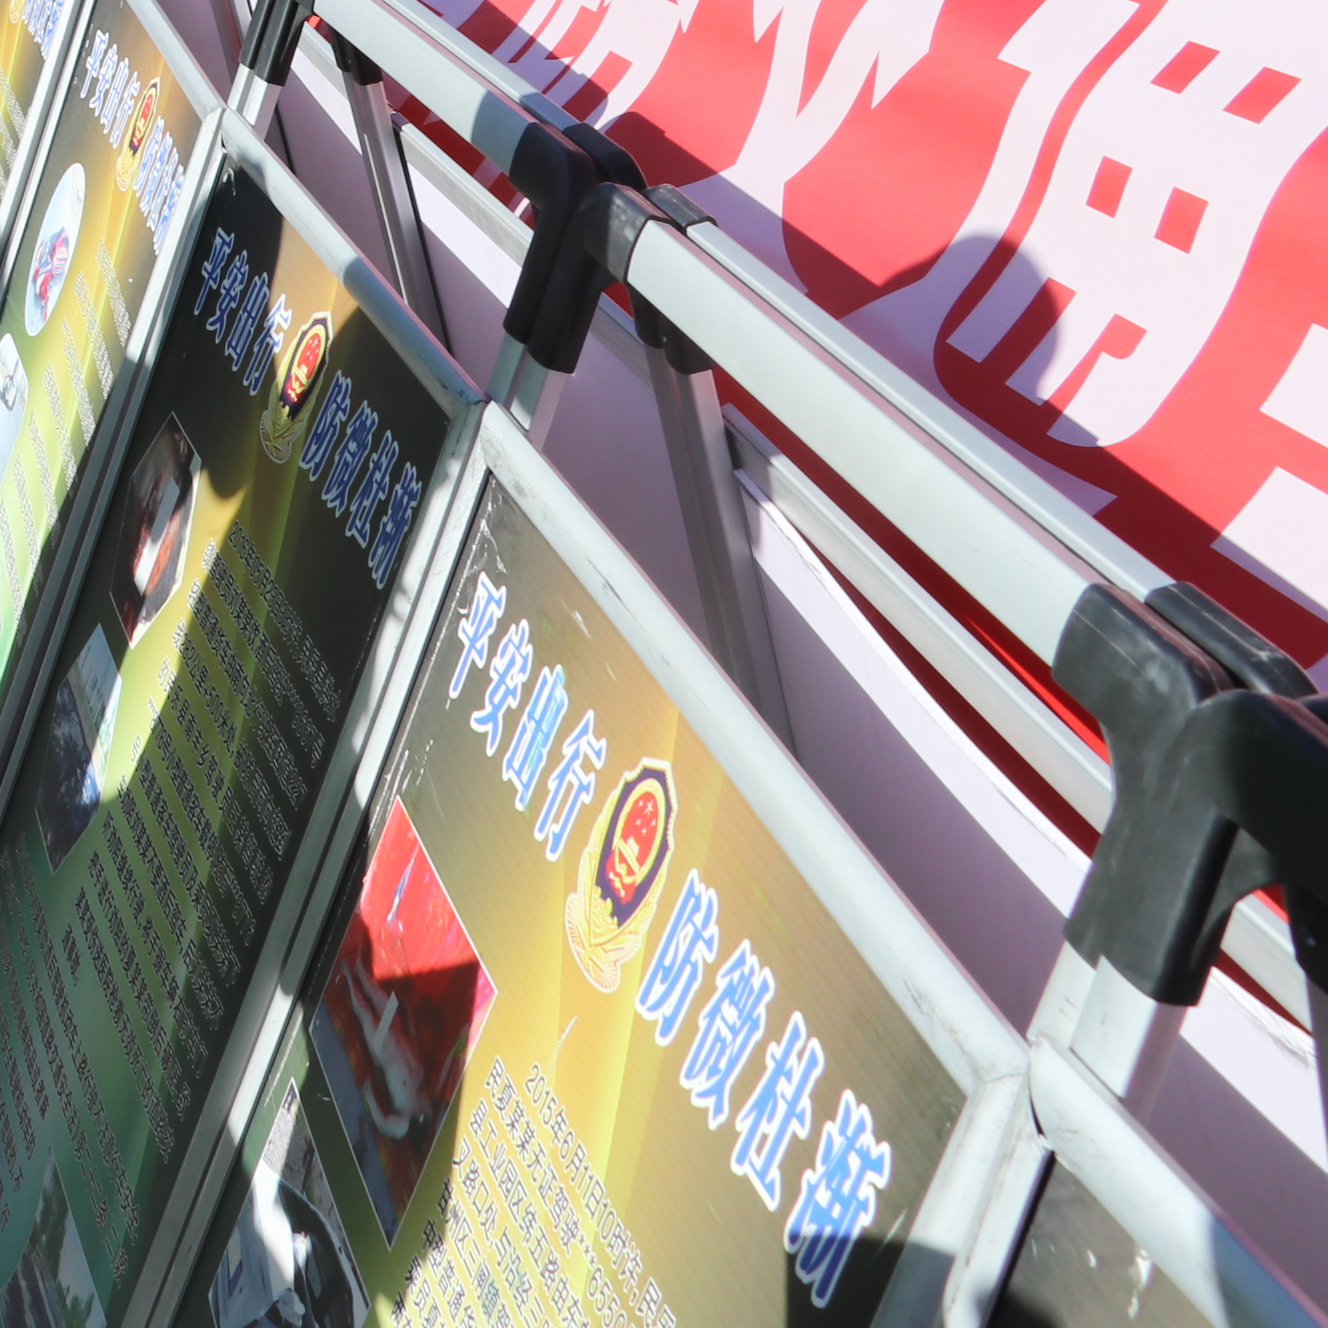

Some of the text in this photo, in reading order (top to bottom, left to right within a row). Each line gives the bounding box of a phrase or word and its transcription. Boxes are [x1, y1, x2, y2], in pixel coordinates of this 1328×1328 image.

[80, 28, 141, 149] 平安出行
[194, 227, 423, 591] 平安出行 防微杜渐
[447, 570, 892, 1309] 平安出行 防微杜渐
[469, 1097, 591, 1328] 县工业园区纬五路由东
